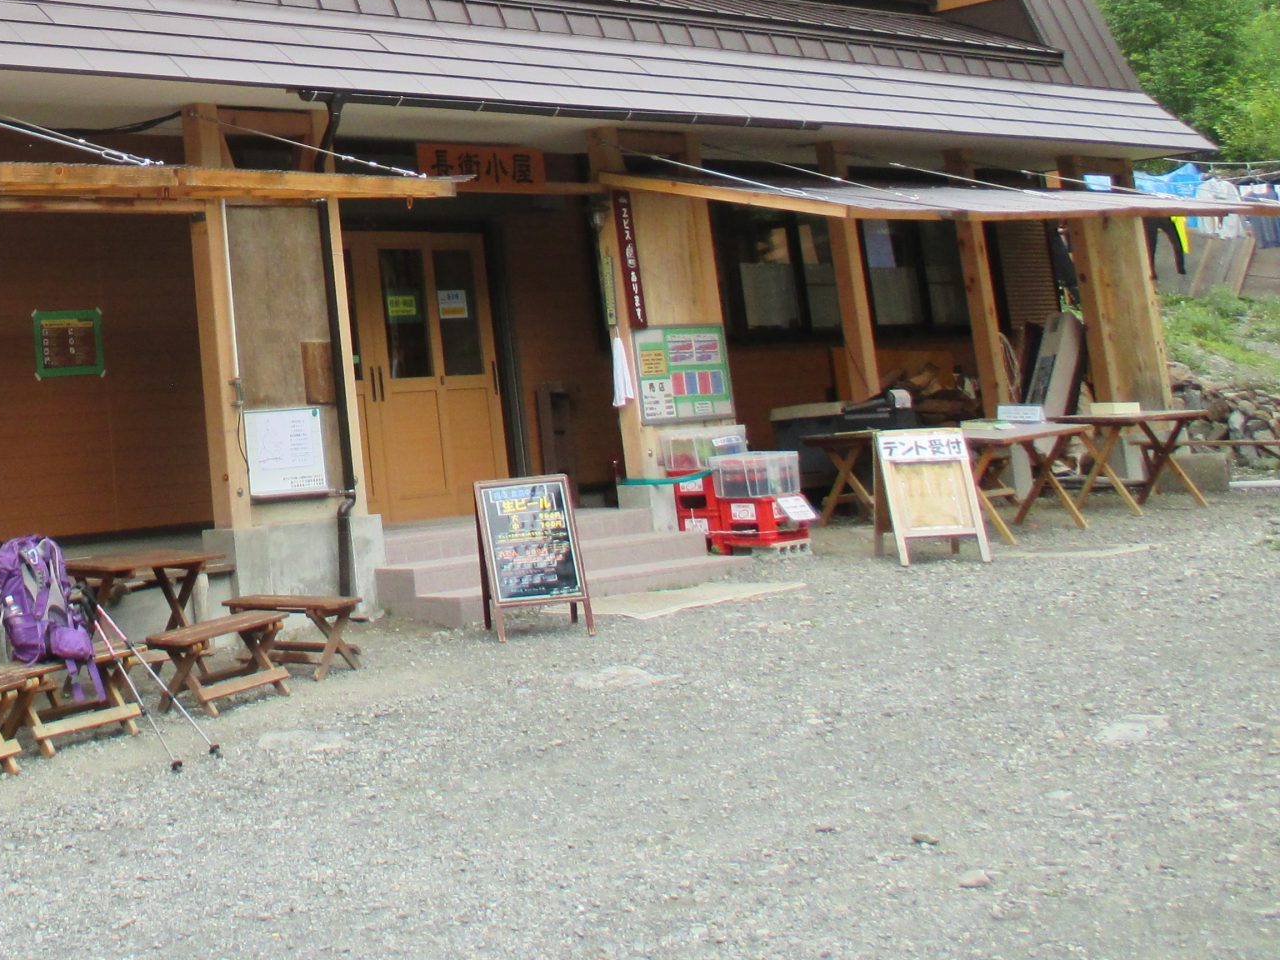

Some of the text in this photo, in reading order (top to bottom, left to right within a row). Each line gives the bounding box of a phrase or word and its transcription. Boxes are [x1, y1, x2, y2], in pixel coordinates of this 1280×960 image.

[882, 438, 962, 456] テント受付
[502, 496, 552, 513] 生ビール
